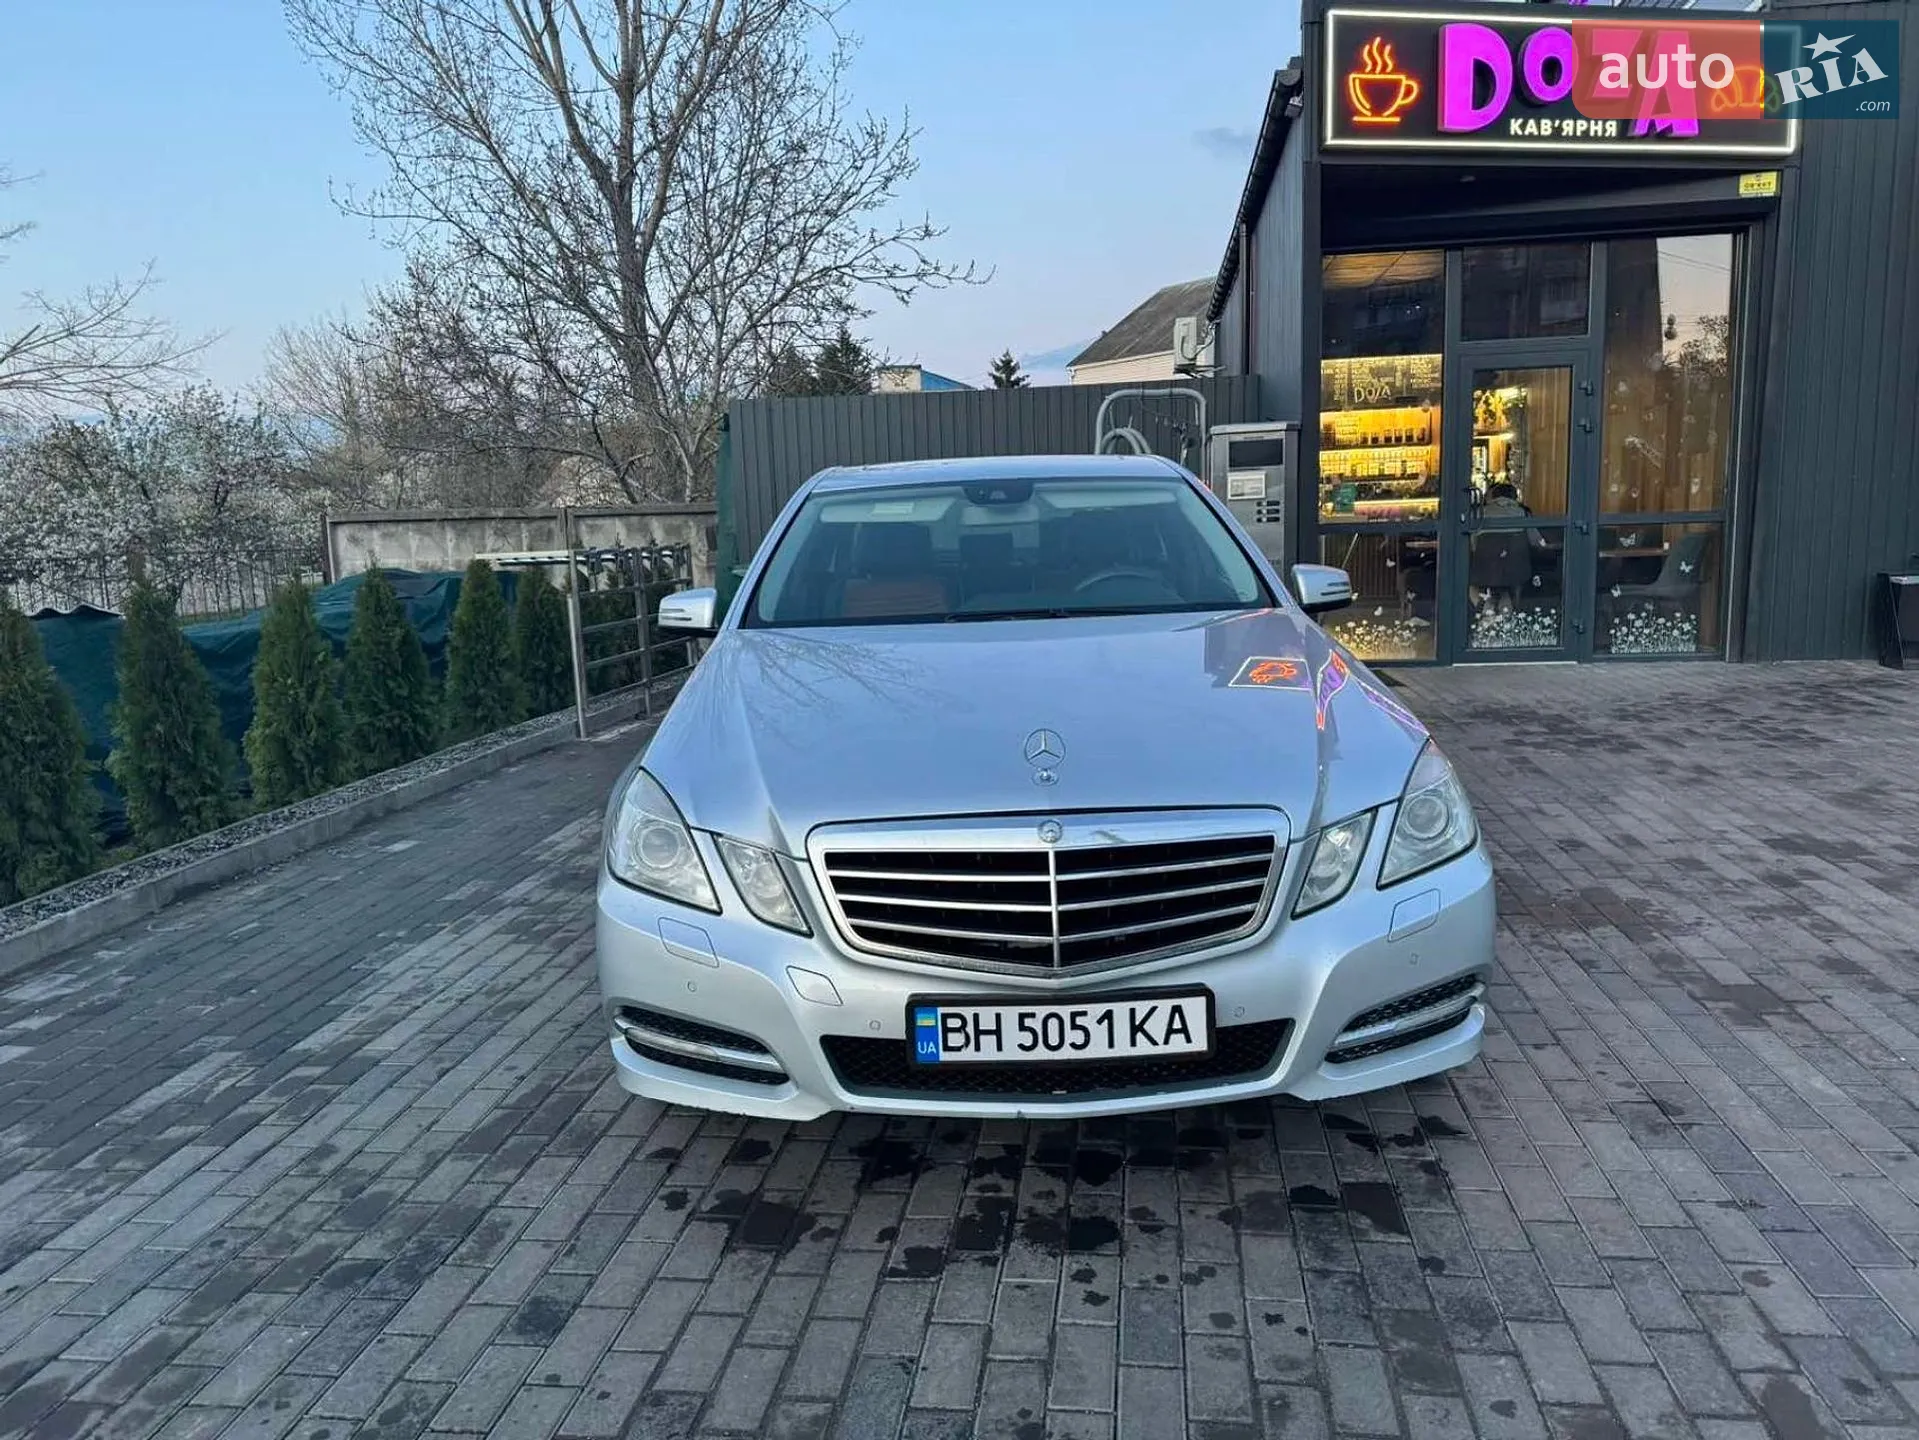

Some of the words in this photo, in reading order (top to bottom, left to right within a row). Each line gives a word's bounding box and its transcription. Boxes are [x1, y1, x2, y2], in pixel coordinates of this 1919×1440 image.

[1438, 22, 1699, 137] DOZA
[1510, 118, 1618, 137] КАВ'ЯРНЯ
[941, 1012, 1003, 1052] BH
[1017, 1009, 1115, 1051] 5051
[1129, 1004, 1193, 1047] KA
[917, 1041, 937, 1054] UA
